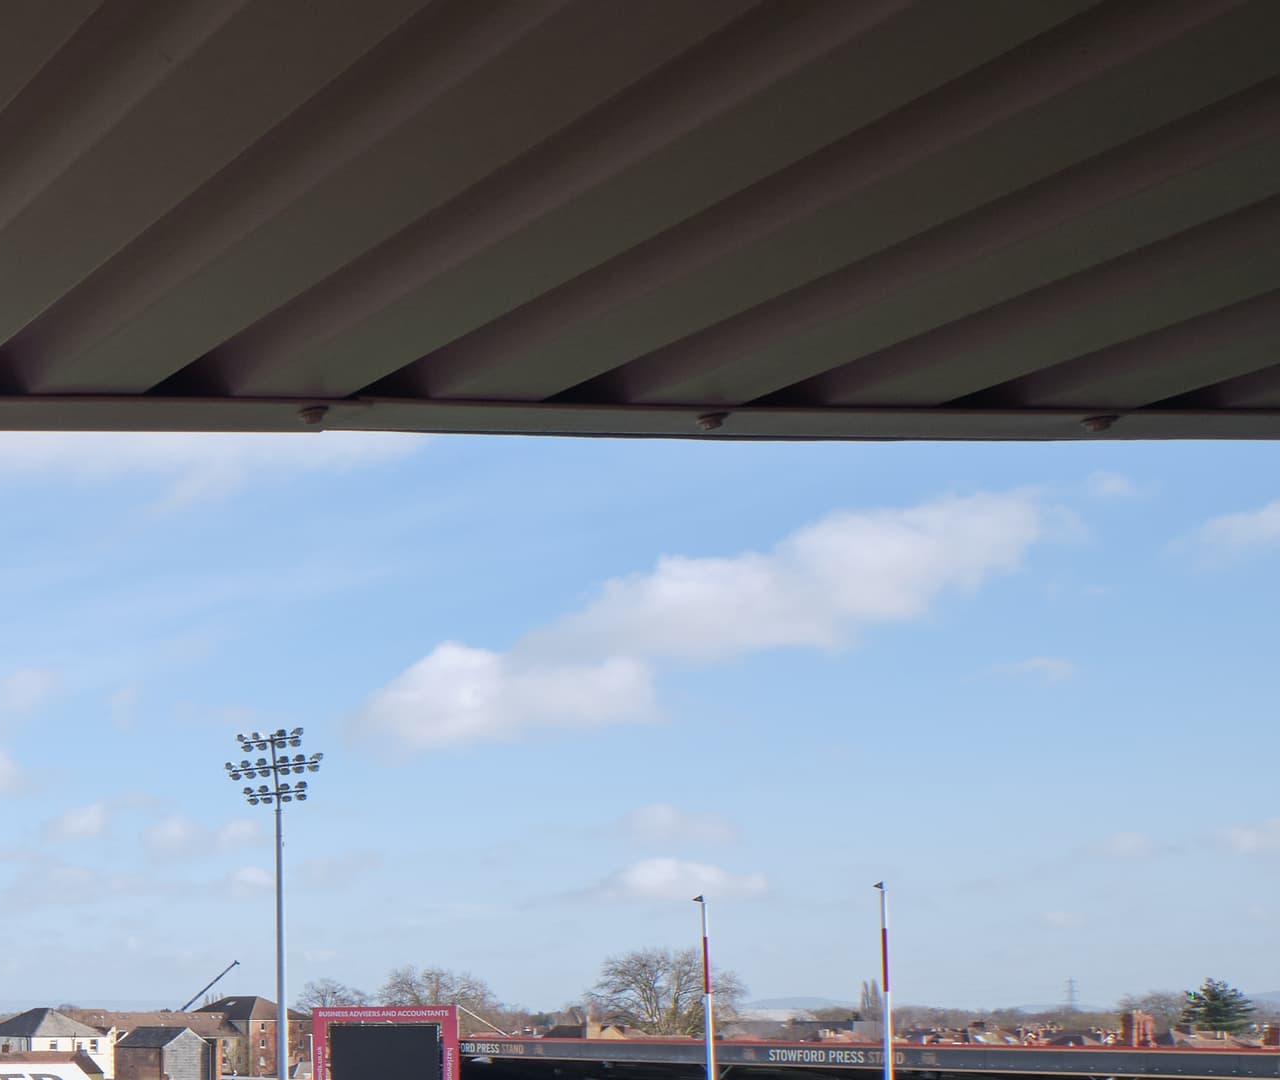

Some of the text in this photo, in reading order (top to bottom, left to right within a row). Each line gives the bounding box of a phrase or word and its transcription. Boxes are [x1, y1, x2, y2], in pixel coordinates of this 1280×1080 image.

[459, 1043, 524, 1055] FORD PRESS STAND
[769, 1049, 826, 1063] STOWFORD
[829, 1051, 864, 1064] PRESS
